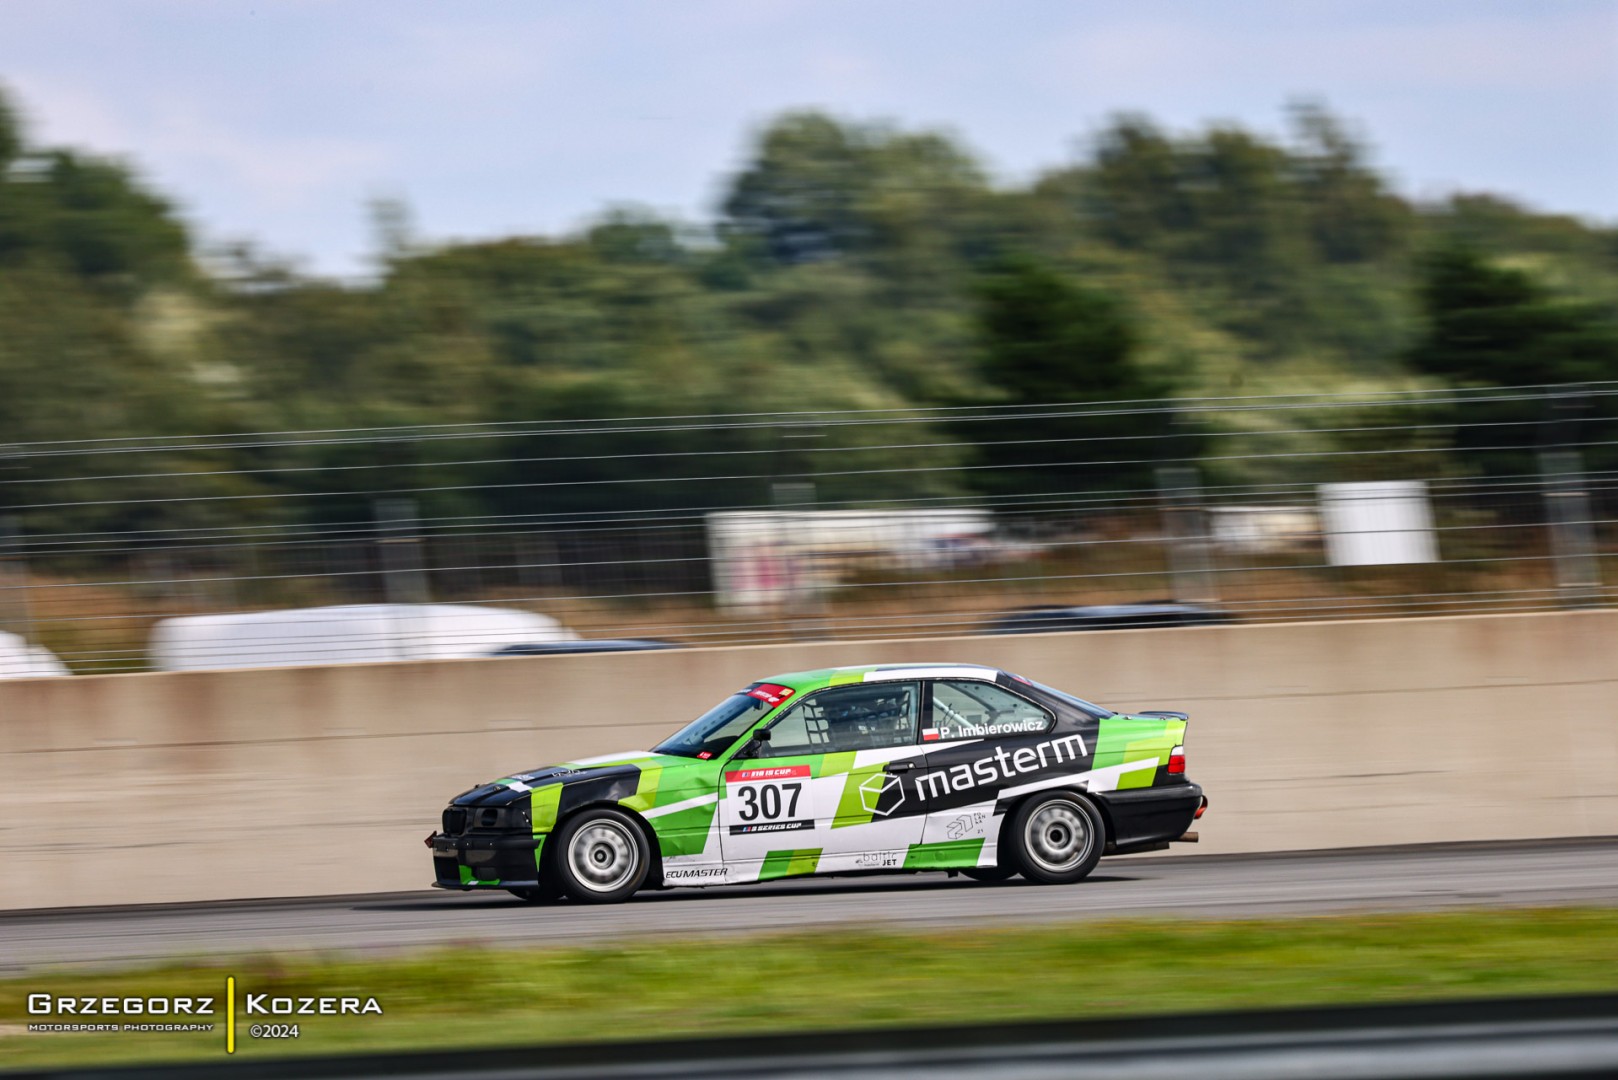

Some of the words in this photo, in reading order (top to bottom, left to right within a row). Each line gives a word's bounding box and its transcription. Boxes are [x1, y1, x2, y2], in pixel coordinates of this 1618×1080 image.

[940, 726, 955, 739] P.
[958, 719, 1044, 737] Imbierowicz
[915, 734, 1088, 801] masterm
[738, 782, 802, 821] 307
